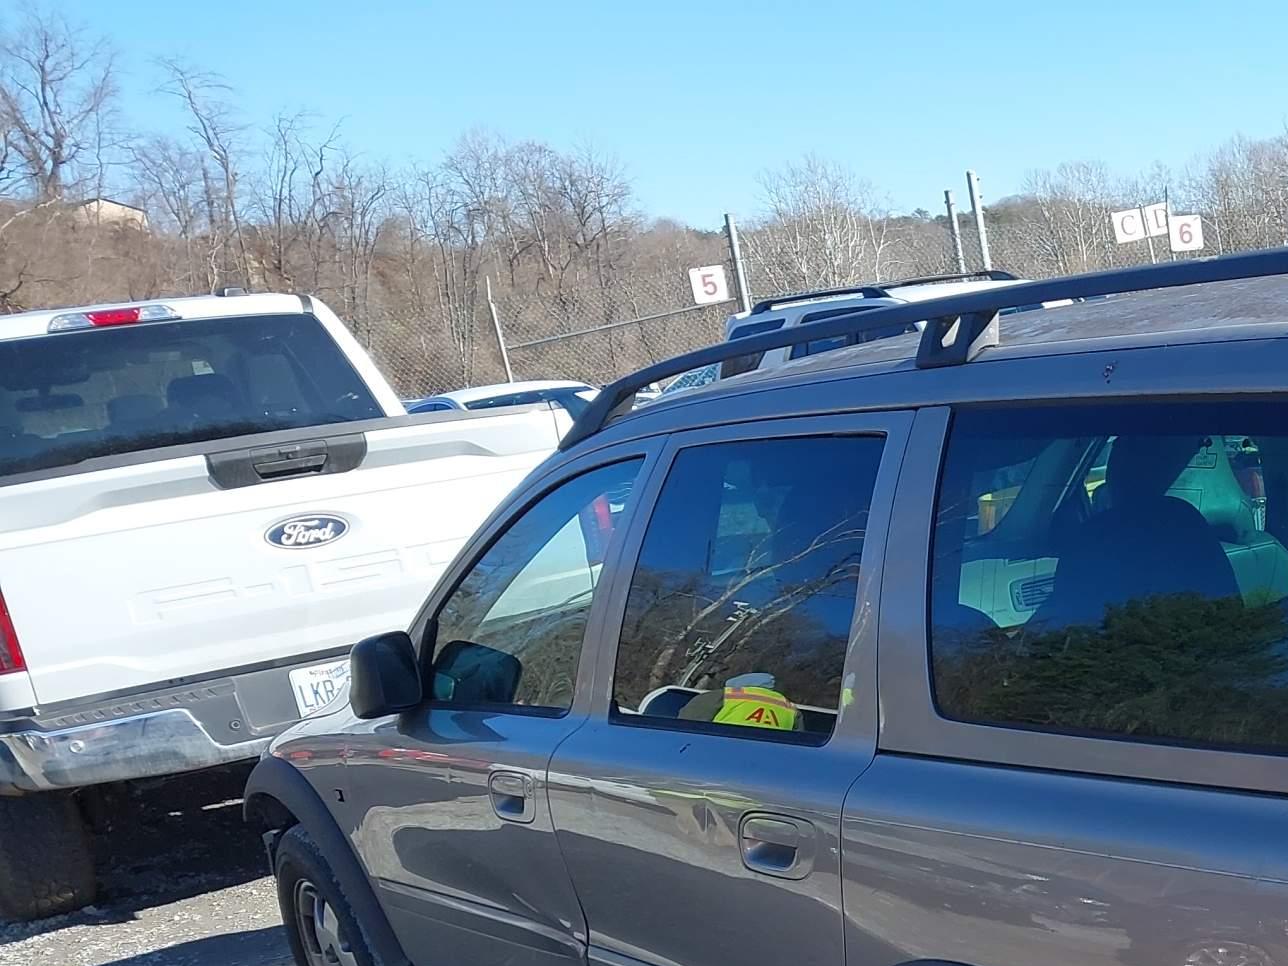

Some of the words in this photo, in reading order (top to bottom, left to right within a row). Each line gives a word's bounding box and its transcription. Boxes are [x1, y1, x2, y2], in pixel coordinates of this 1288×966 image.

[1120, 214, 1137, 236] C
[1178, 222, 1193, 244] 6
[700, 273, 718, 296] 5
[280, 518, 335, 546] Ford
